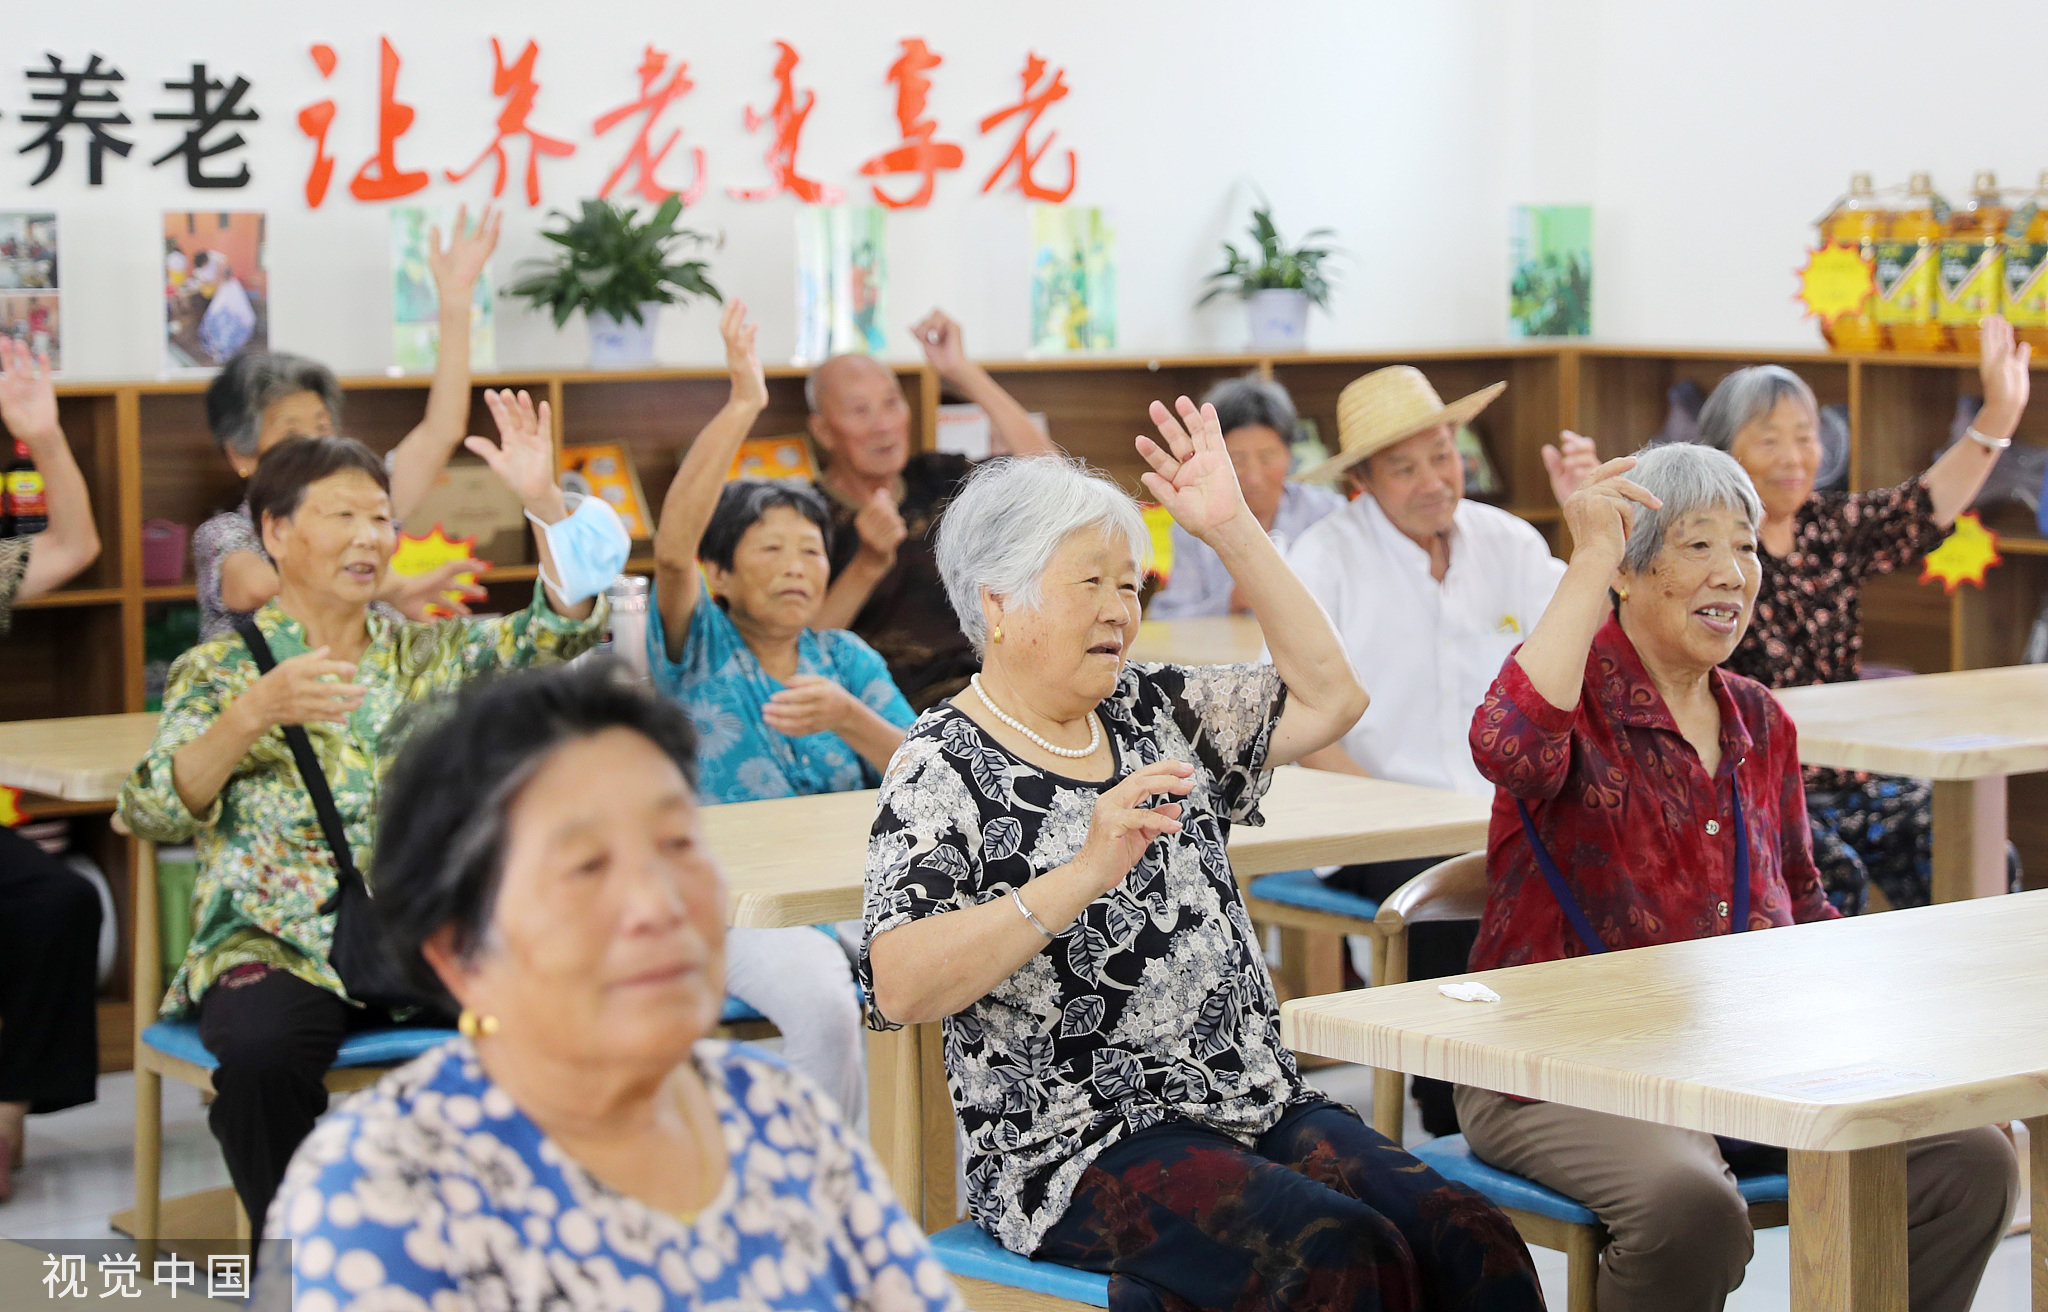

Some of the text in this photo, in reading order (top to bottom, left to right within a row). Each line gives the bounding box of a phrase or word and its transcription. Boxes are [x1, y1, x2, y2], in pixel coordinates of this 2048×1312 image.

[0, 35, 1077, 211] 养老 让养老变享老
